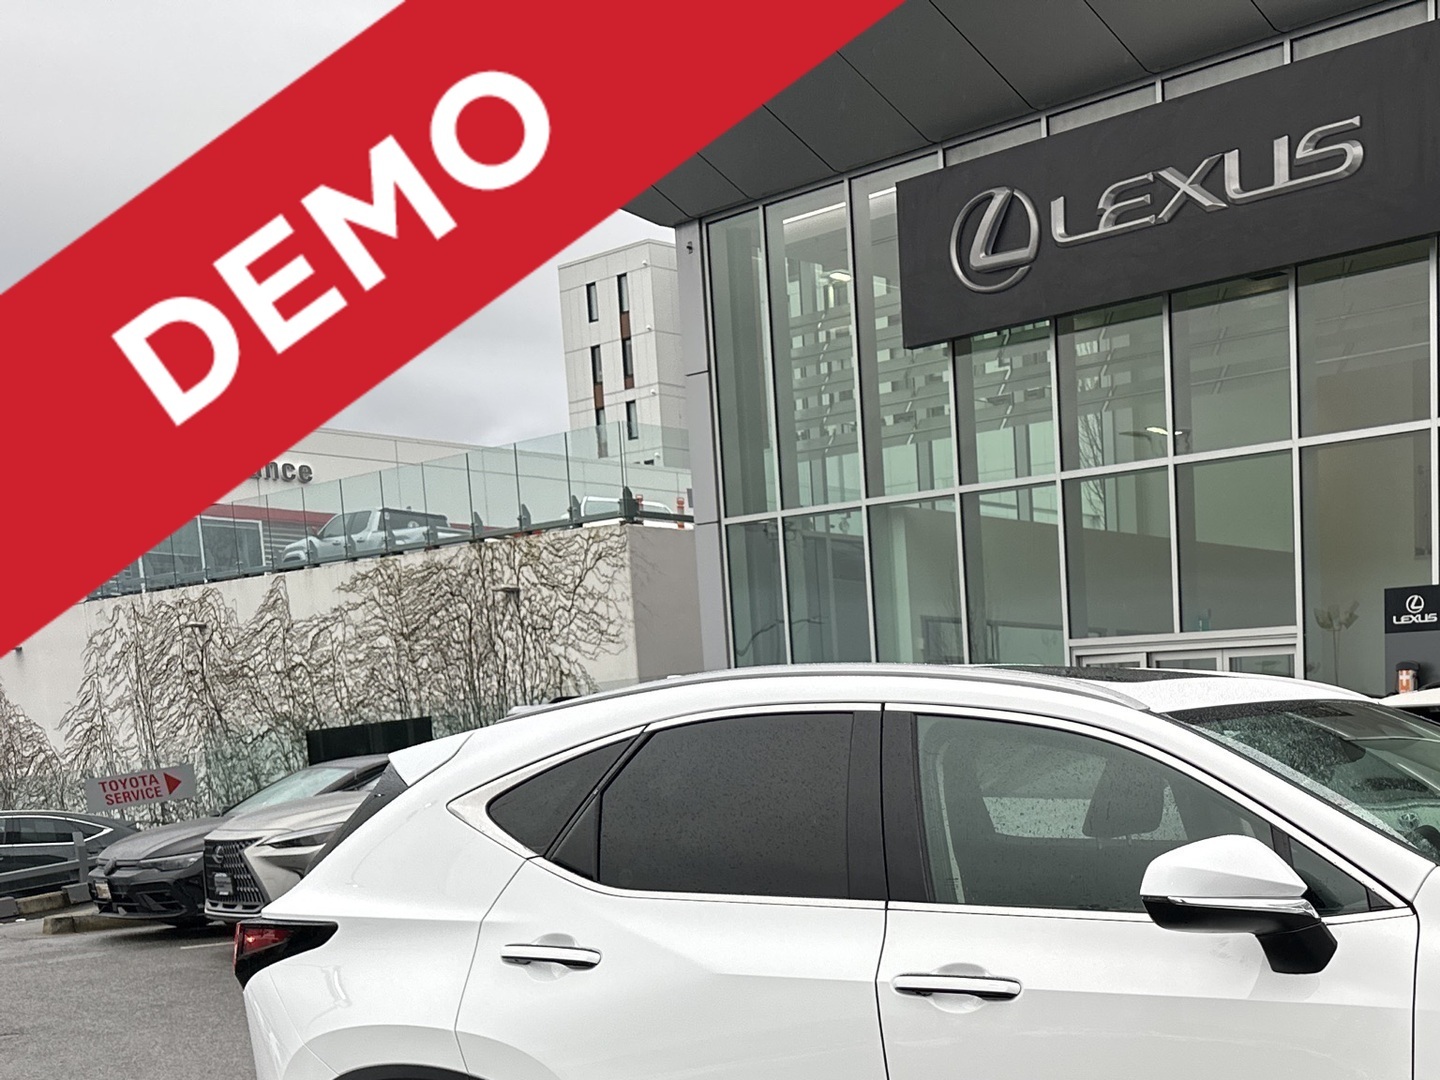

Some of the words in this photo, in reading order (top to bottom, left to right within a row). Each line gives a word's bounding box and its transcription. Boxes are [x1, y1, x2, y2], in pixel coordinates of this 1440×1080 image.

[1050, 115, 1365, 248] LEXUS
[1393, 613, 1438, 624] LEXUS
[98, 774, 160, 793] TOYOTA
[105, 786, 163, 806] SERVICE
